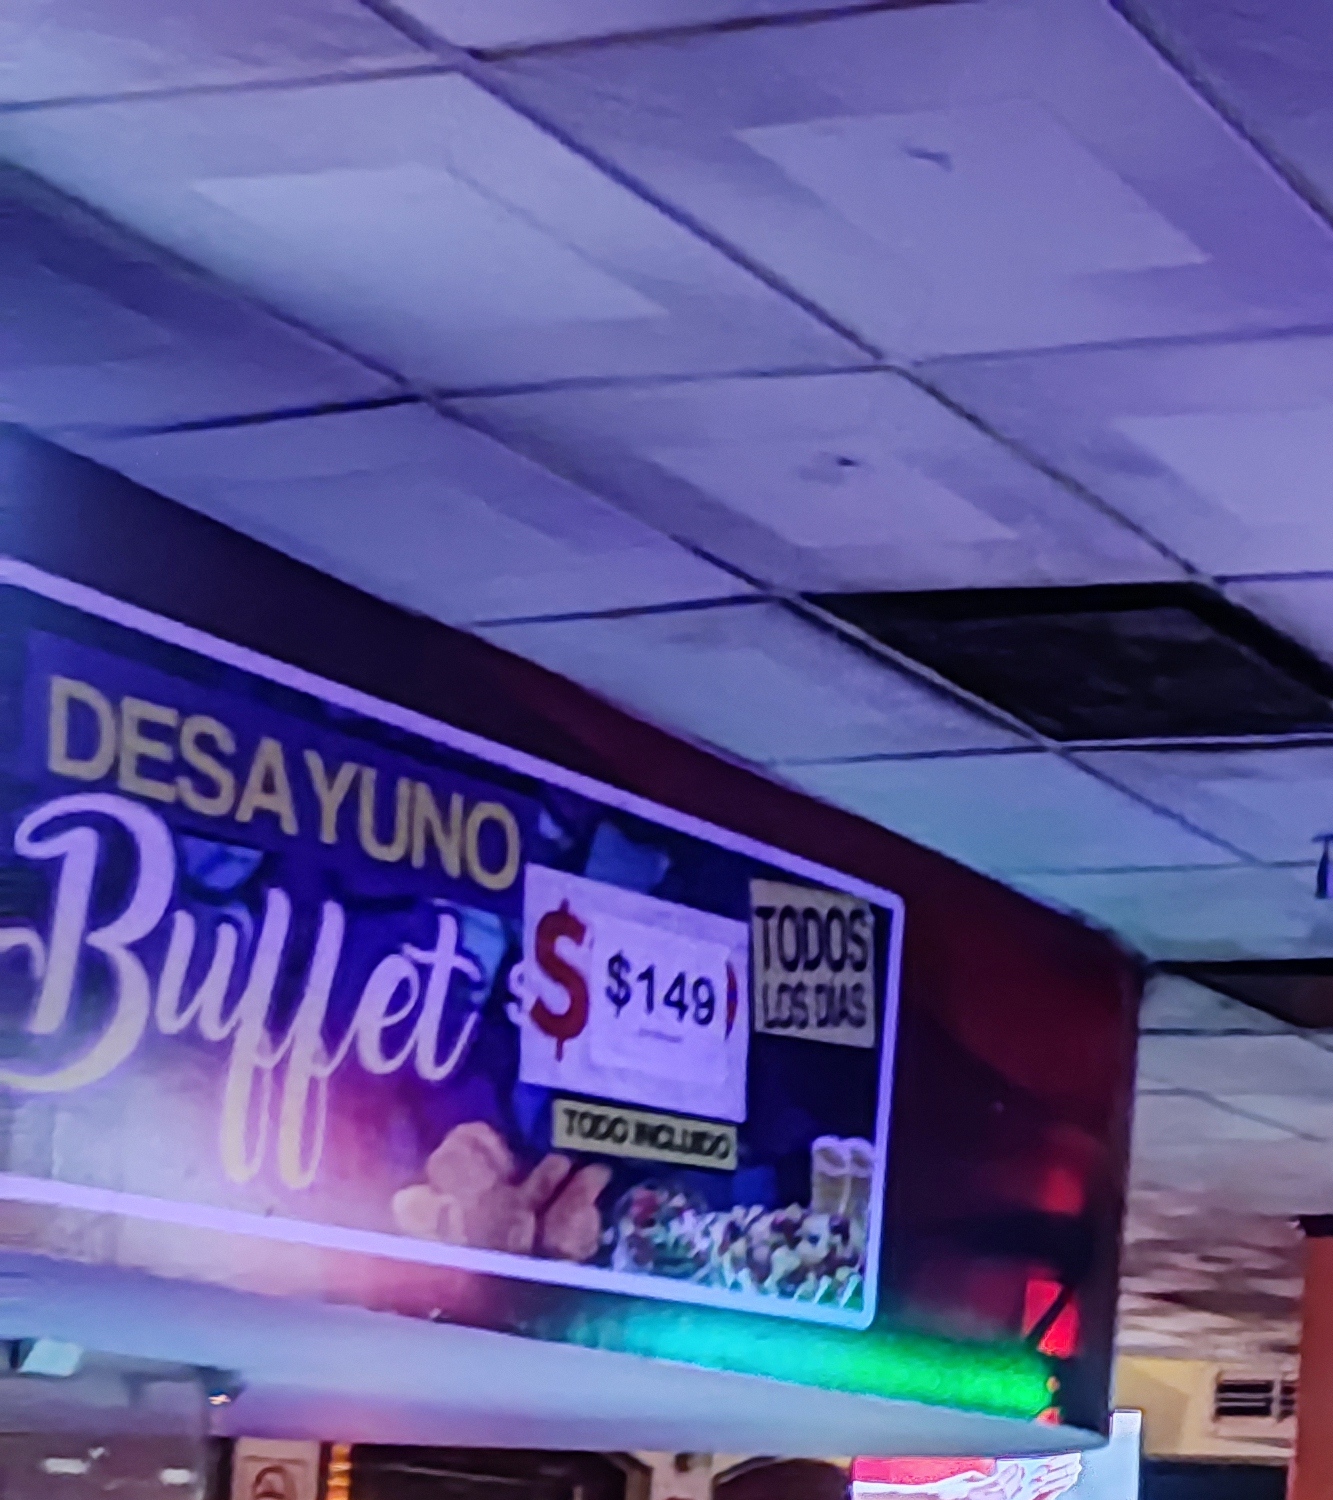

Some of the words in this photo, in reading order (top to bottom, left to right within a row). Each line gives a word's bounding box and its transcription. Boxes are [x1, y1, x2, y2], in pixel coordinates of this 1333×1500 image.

[48, 675, 521, 891] DESAYUNO
[754, 904, 869, 973] TODOS
[0, 793, 488, 1190] Buffet
[604, 950, 716, 1026] $149
[563, 1107, 630, 1144] TODO
